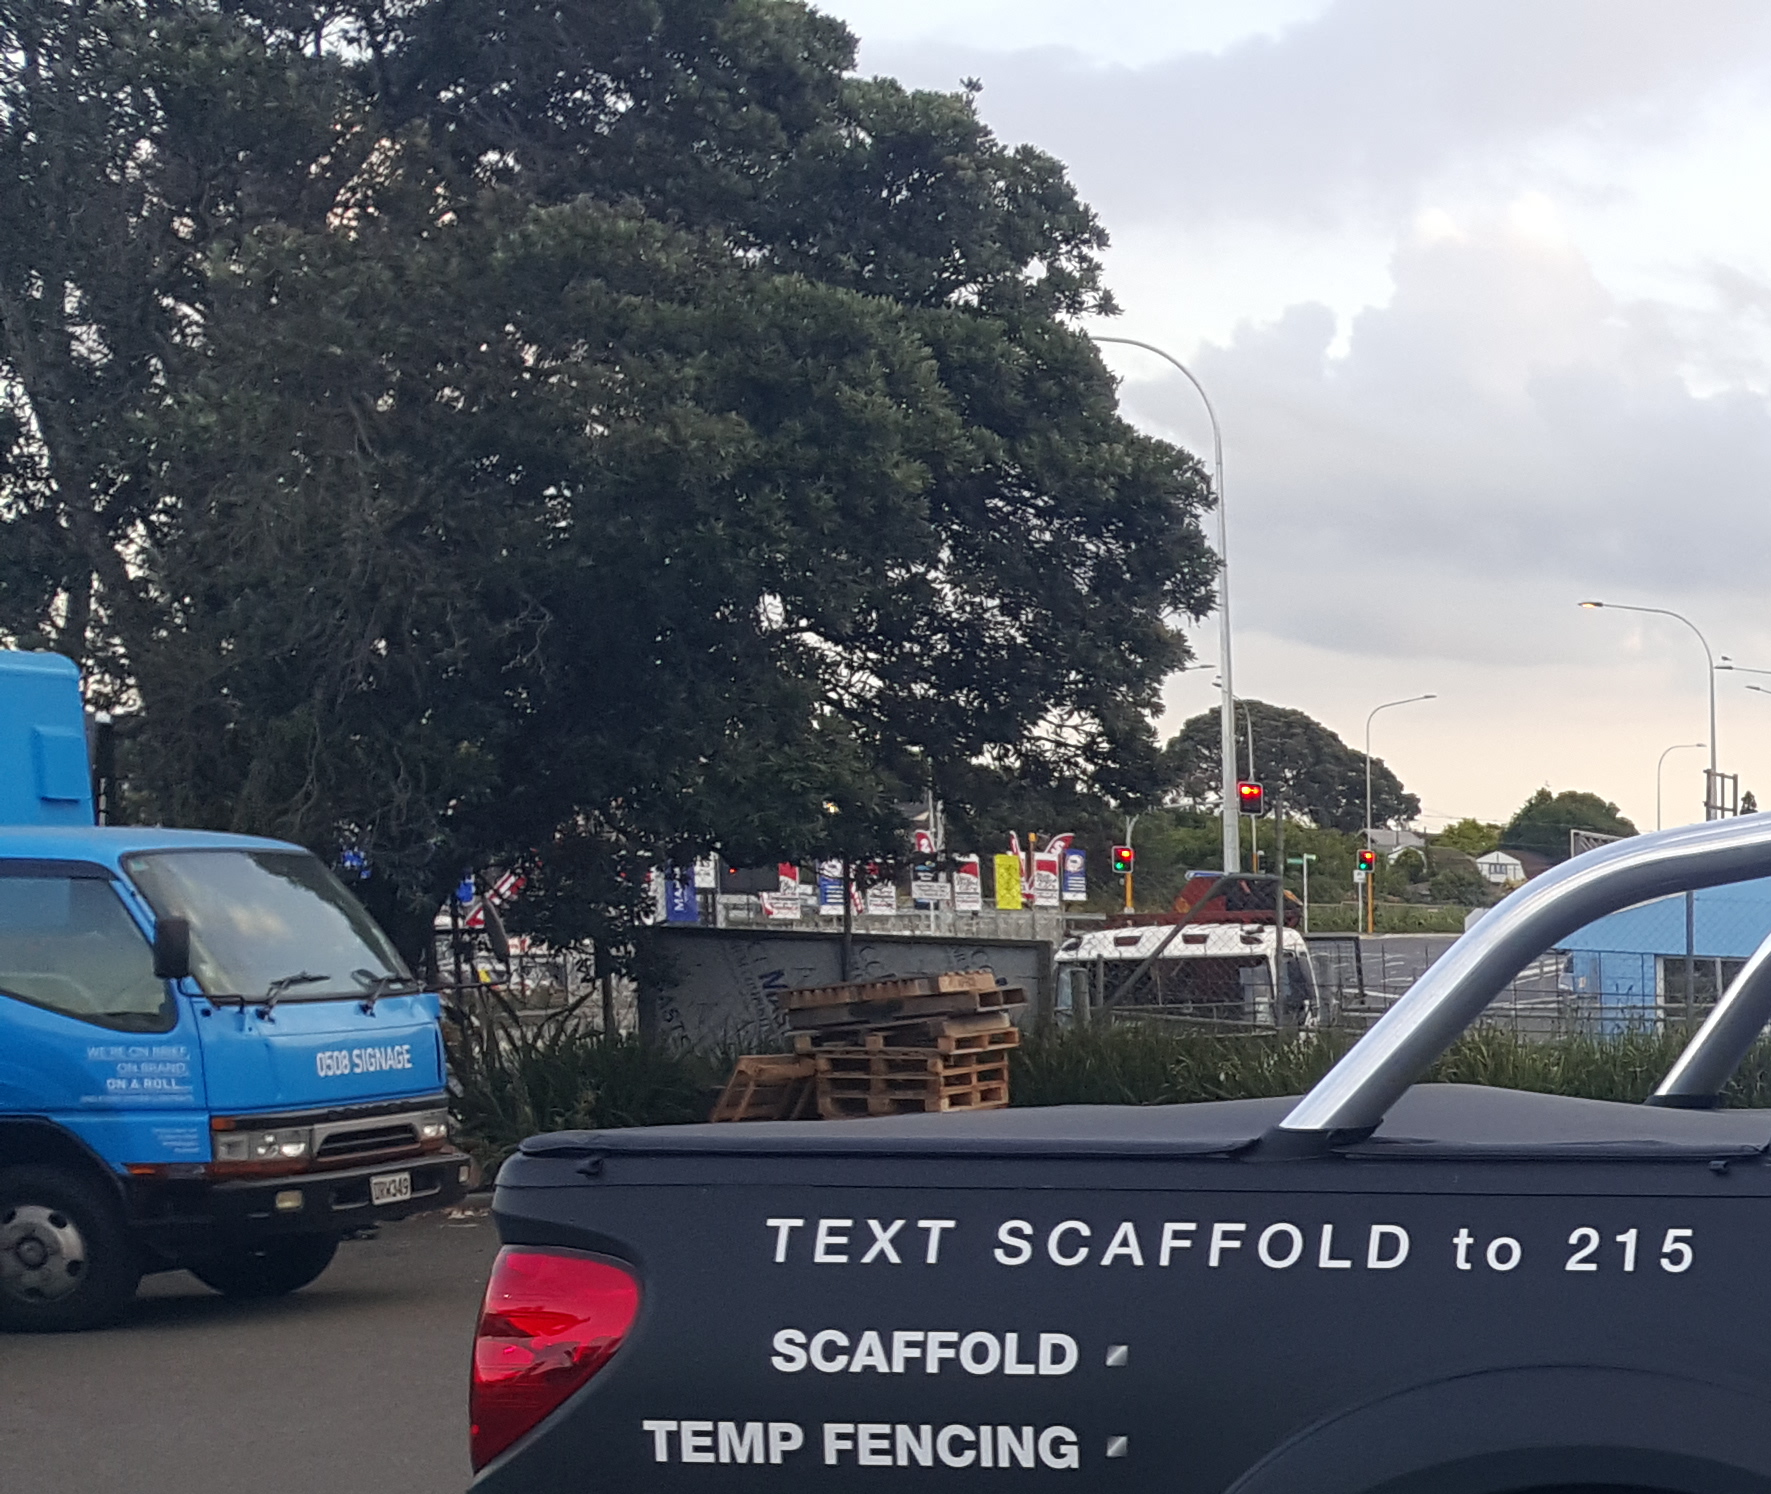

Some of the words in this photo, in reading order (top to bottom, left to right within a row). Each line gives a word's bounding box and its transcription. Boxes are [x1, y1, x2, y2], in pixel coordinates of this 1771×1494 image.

[316, 1051, 350, 1077] 0508
[352, 1045, 413, 1073] SIGNAGE
[766, 1218, 956, 1264] TEXT
[993, 1219, 1410, 1270] SCAFFOLD
[1452, 1228, 1523, 1271] to
[1564, 1226, 1694, 1273] 215
[770, 1328, 1079, 1375] SCAFFOLD
[642, 1419, 804, 1464] TEMP
[822, 1422, 1080, 1469] FENCING
